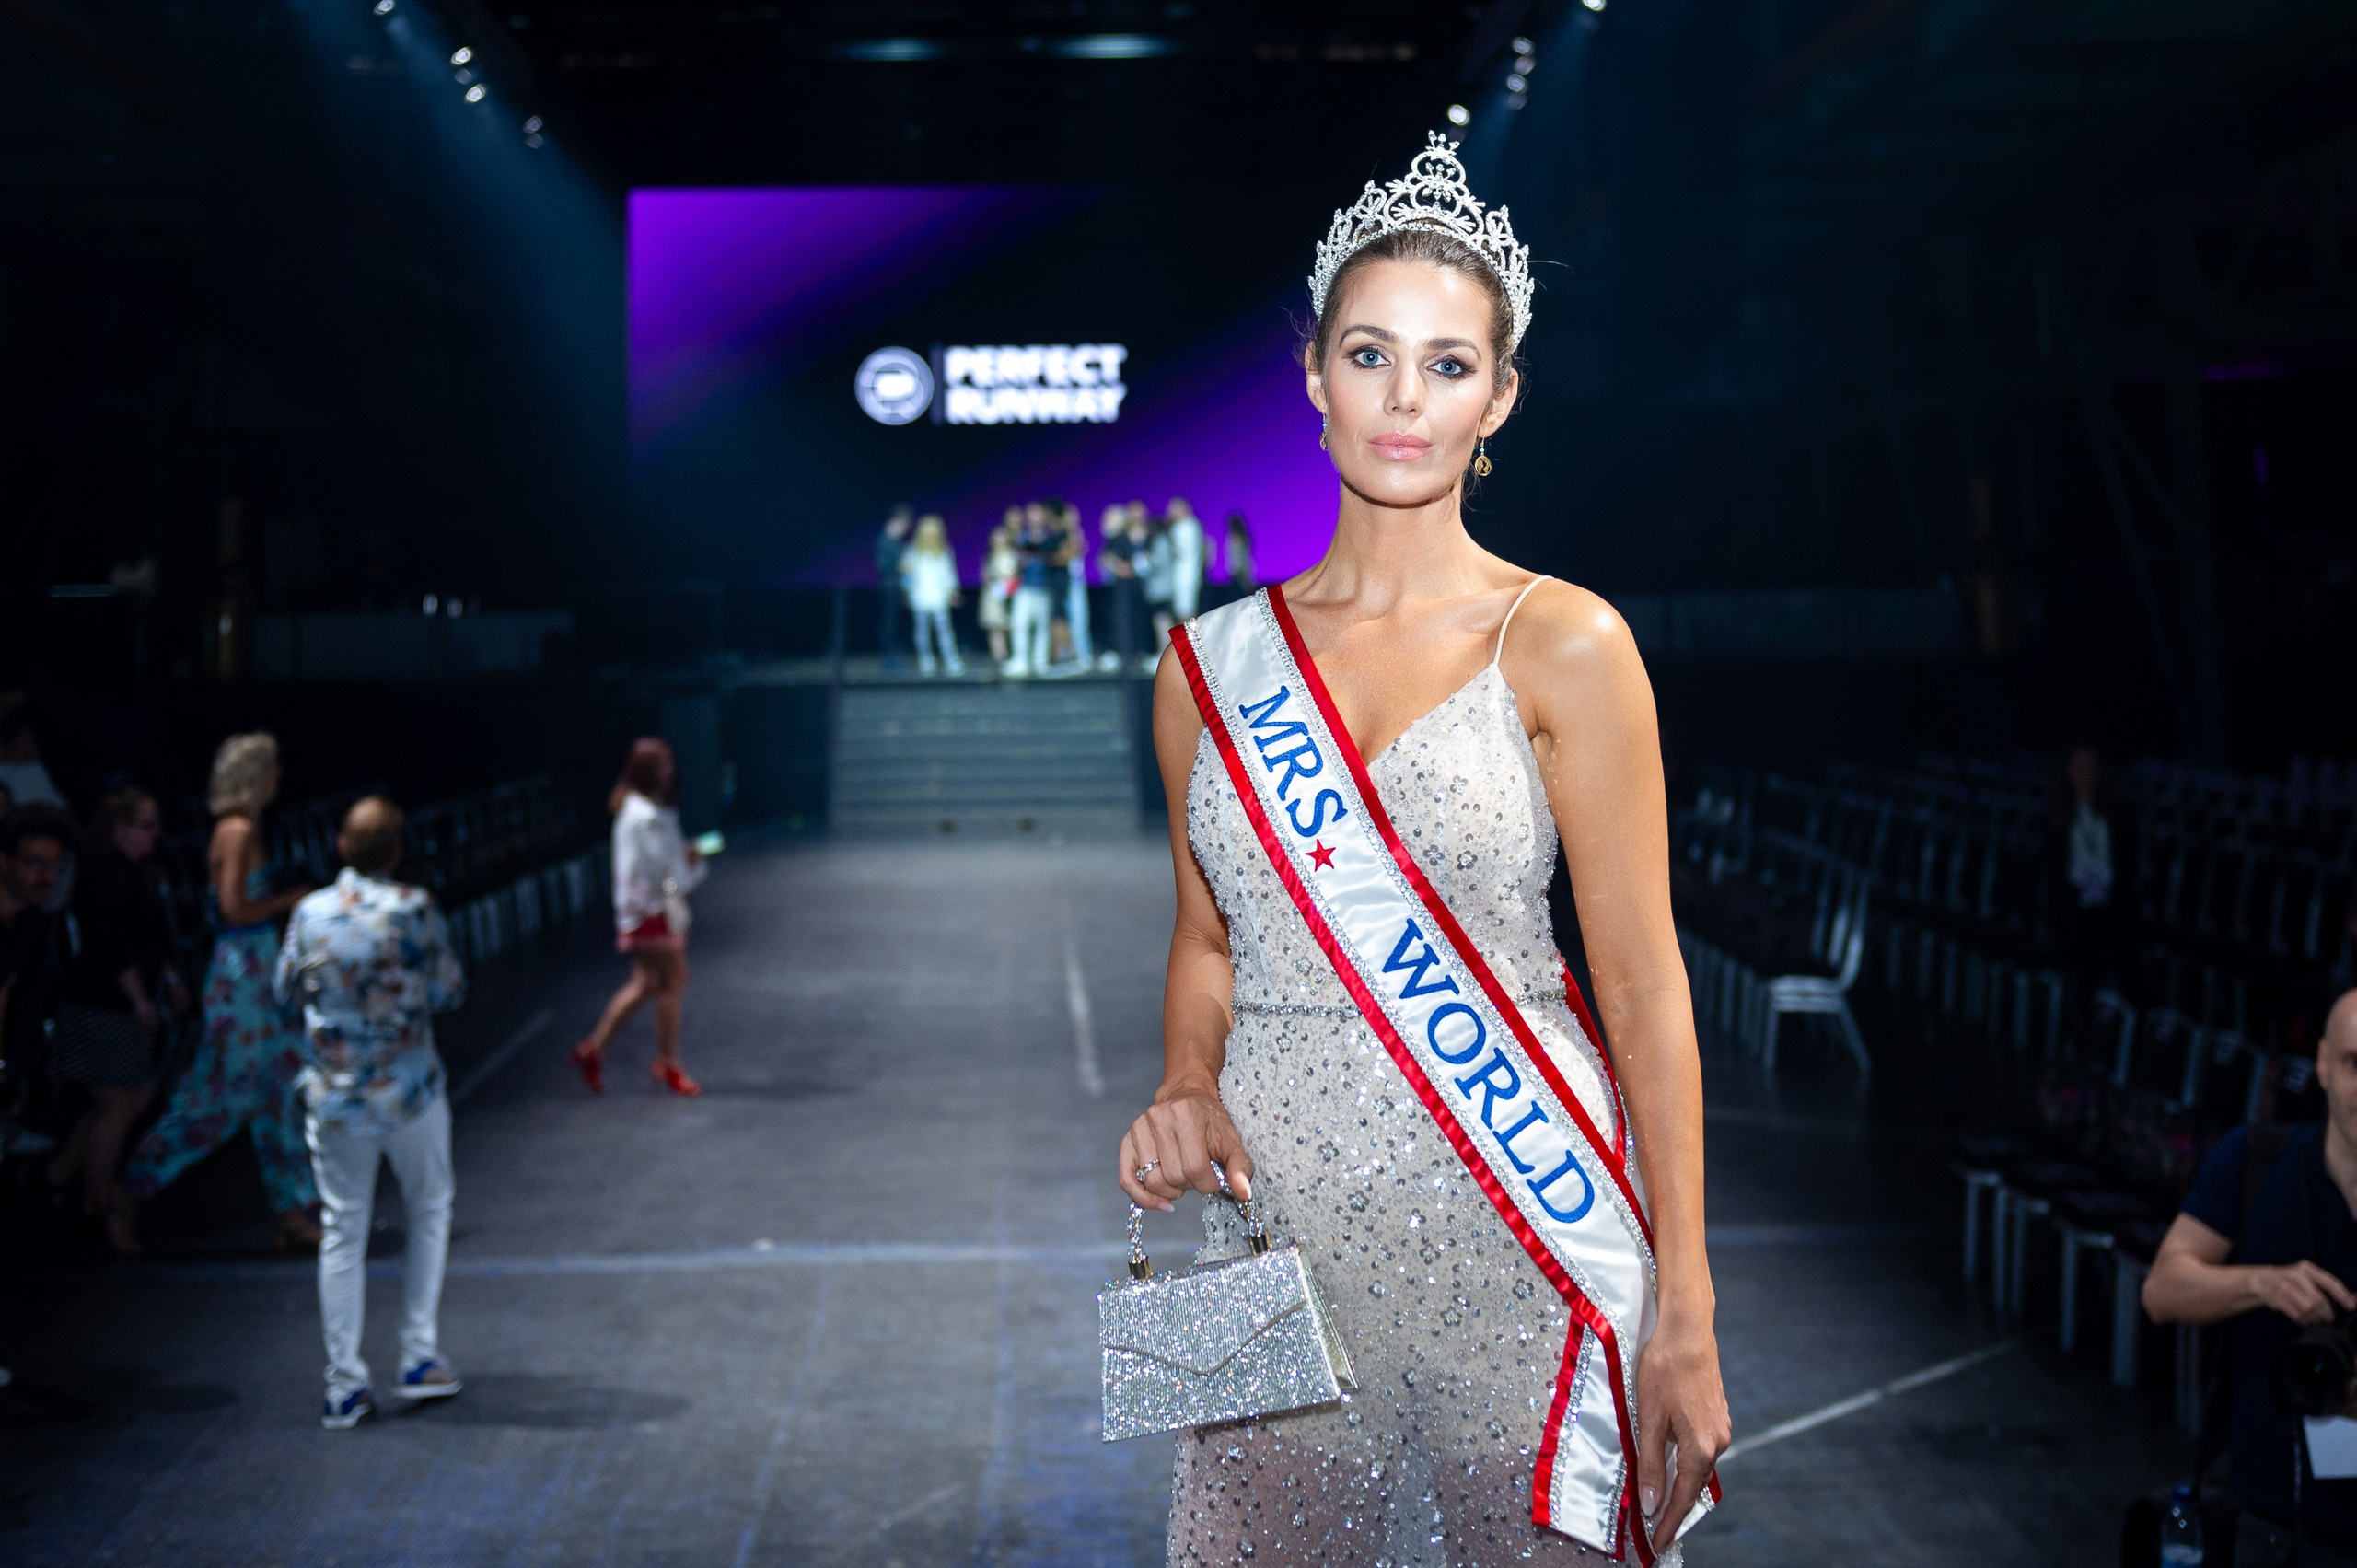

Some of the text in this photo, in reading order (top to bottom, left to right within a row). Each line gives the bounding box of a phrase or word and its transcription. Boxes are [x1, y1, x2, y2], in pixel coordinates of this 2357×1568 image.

[945, 344, 1127, 387] PERFECT
[946, 385, 1126, 424] RUNWAY
[1238, 684, 1596, 1224] MRS WORLD
